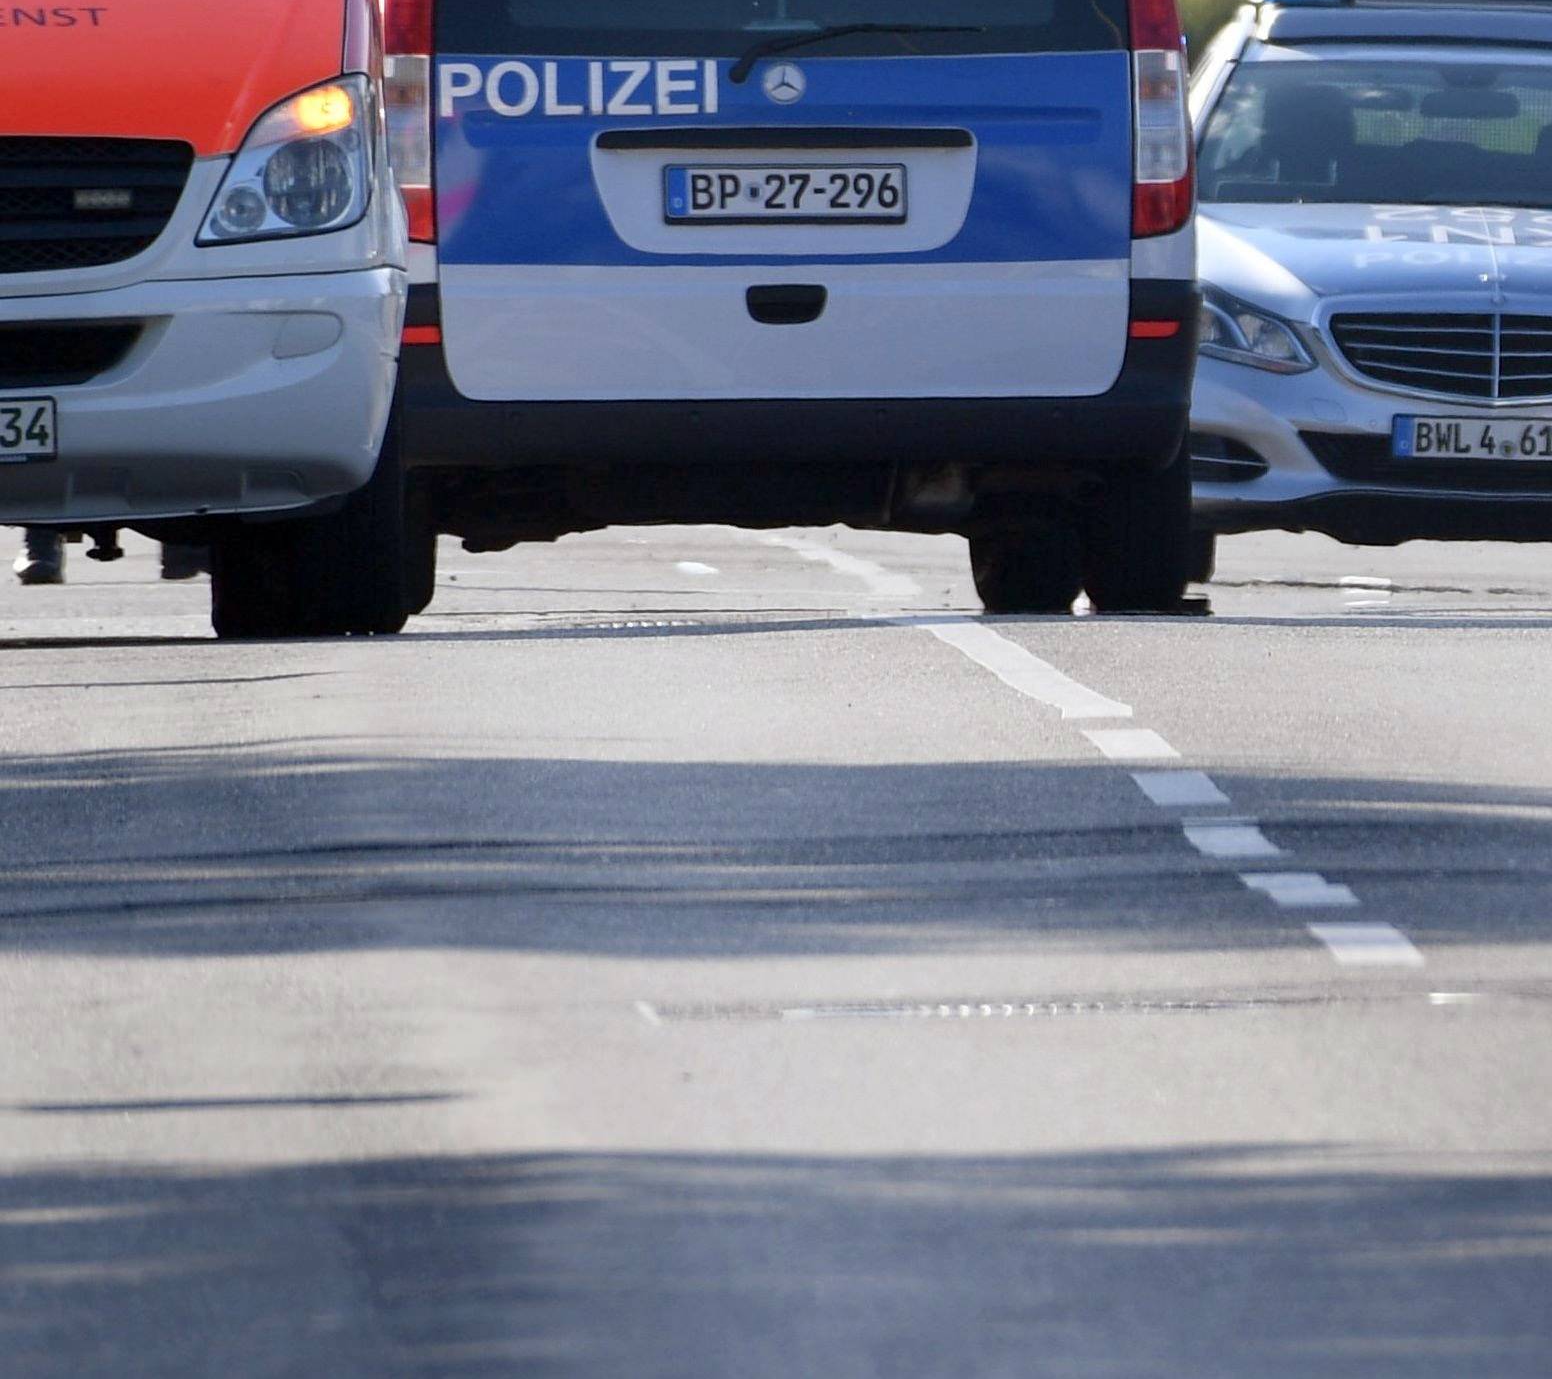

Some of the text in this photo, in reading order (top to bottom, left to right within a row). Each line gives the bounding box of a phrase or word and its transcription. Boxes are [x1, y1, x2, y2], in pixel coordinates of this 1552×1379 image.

[438, 60, 719, 118] POLIZEI
[691, 173, 899, 210] BP 27-296
[1416, 422, 1471, 454] BWL
[1480, 424, 1496, 454] 4
